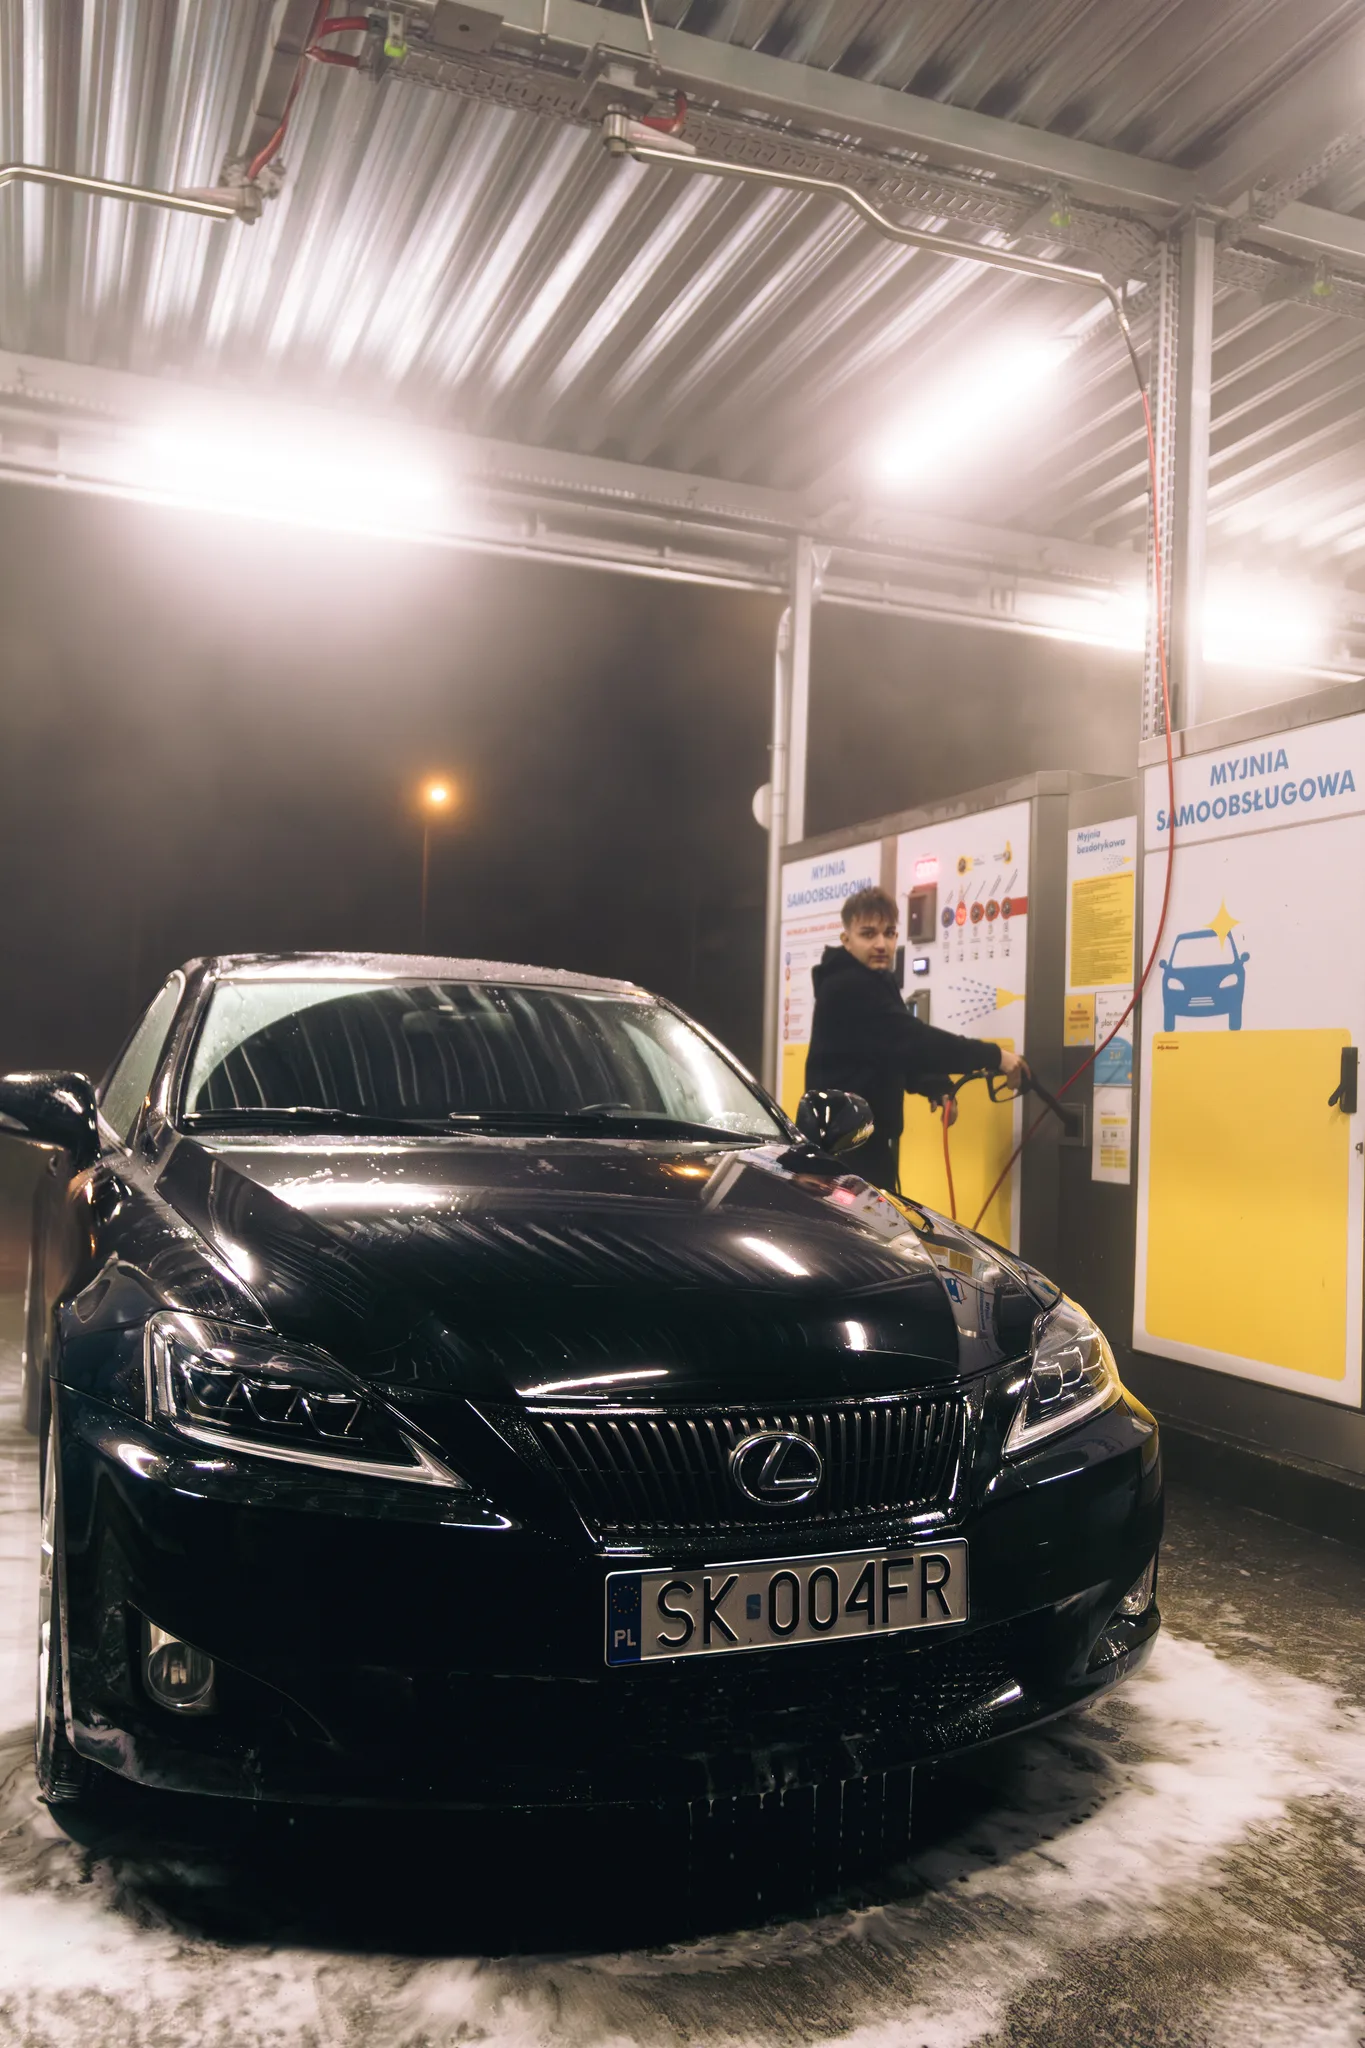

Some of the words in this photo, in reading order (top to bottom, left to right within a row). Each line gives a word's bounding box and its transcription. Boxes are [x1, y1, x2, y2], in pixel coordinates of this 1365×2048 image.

[1210, 748, 1289, 787] MYJNIA
[1156, 769, 1356, 832] SAMOOBSŁUGOWA
[1076, 838, 1126, 854] bezdotykowa
[1077, 829, 1101, 843] Myjnia
[811, 859, 846, 880] MYJNIA
[656, 1573, 740, 1648] SK
[768, 1552, 952, 1637] 004FR
[614, 1629, 637, 1648] PL
